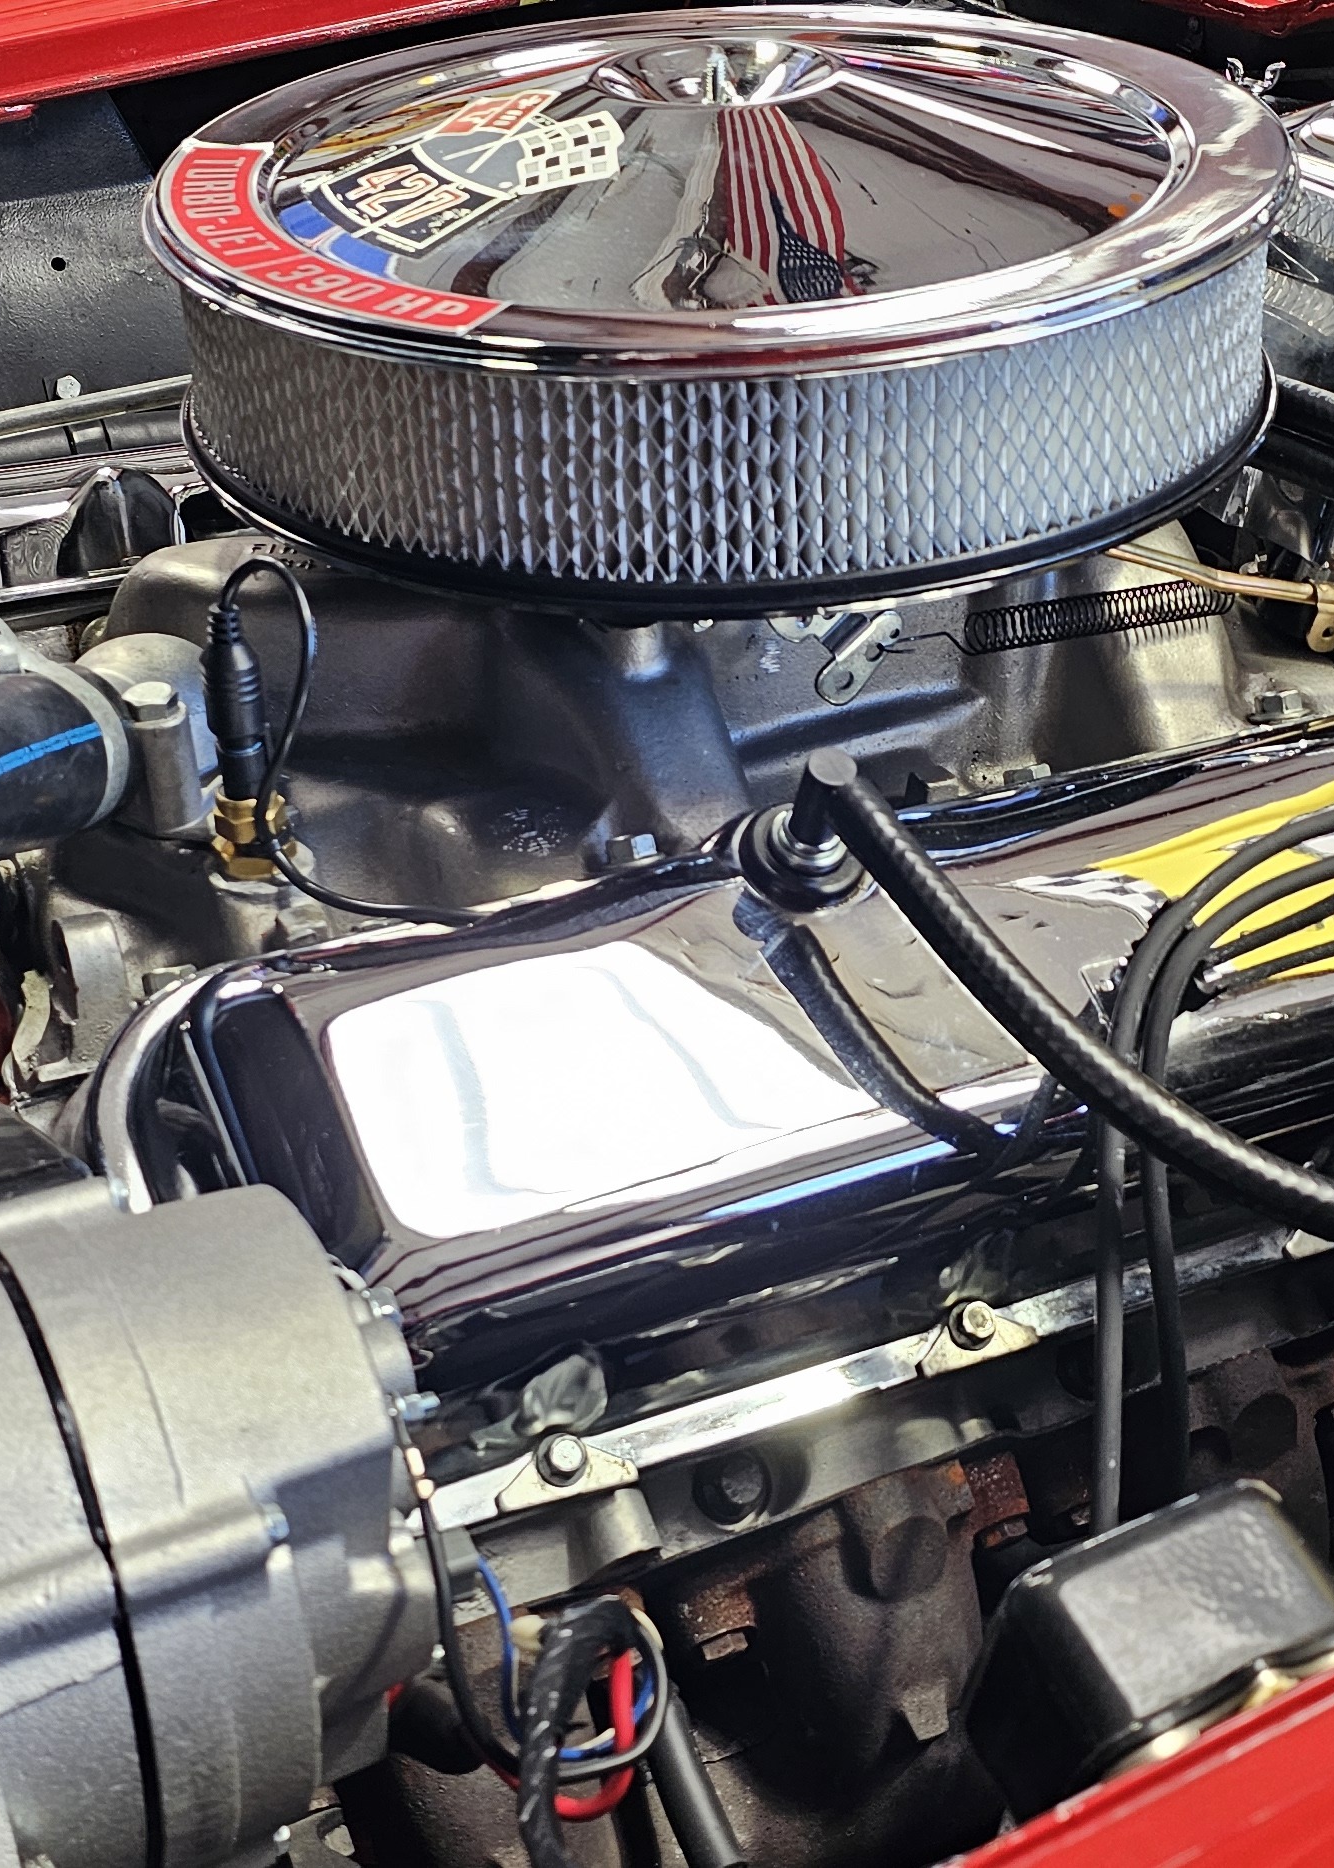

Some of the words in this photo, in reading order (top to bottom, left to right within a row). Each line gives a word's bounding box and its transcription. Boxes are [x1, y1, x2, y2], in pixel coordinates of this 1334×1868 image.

[182, 156, 281, 256] TURBO-JET
[266, 263, 386, 302] 390
[372, 293, 470, 320] HP
[345, 163, 470, 228] 427
